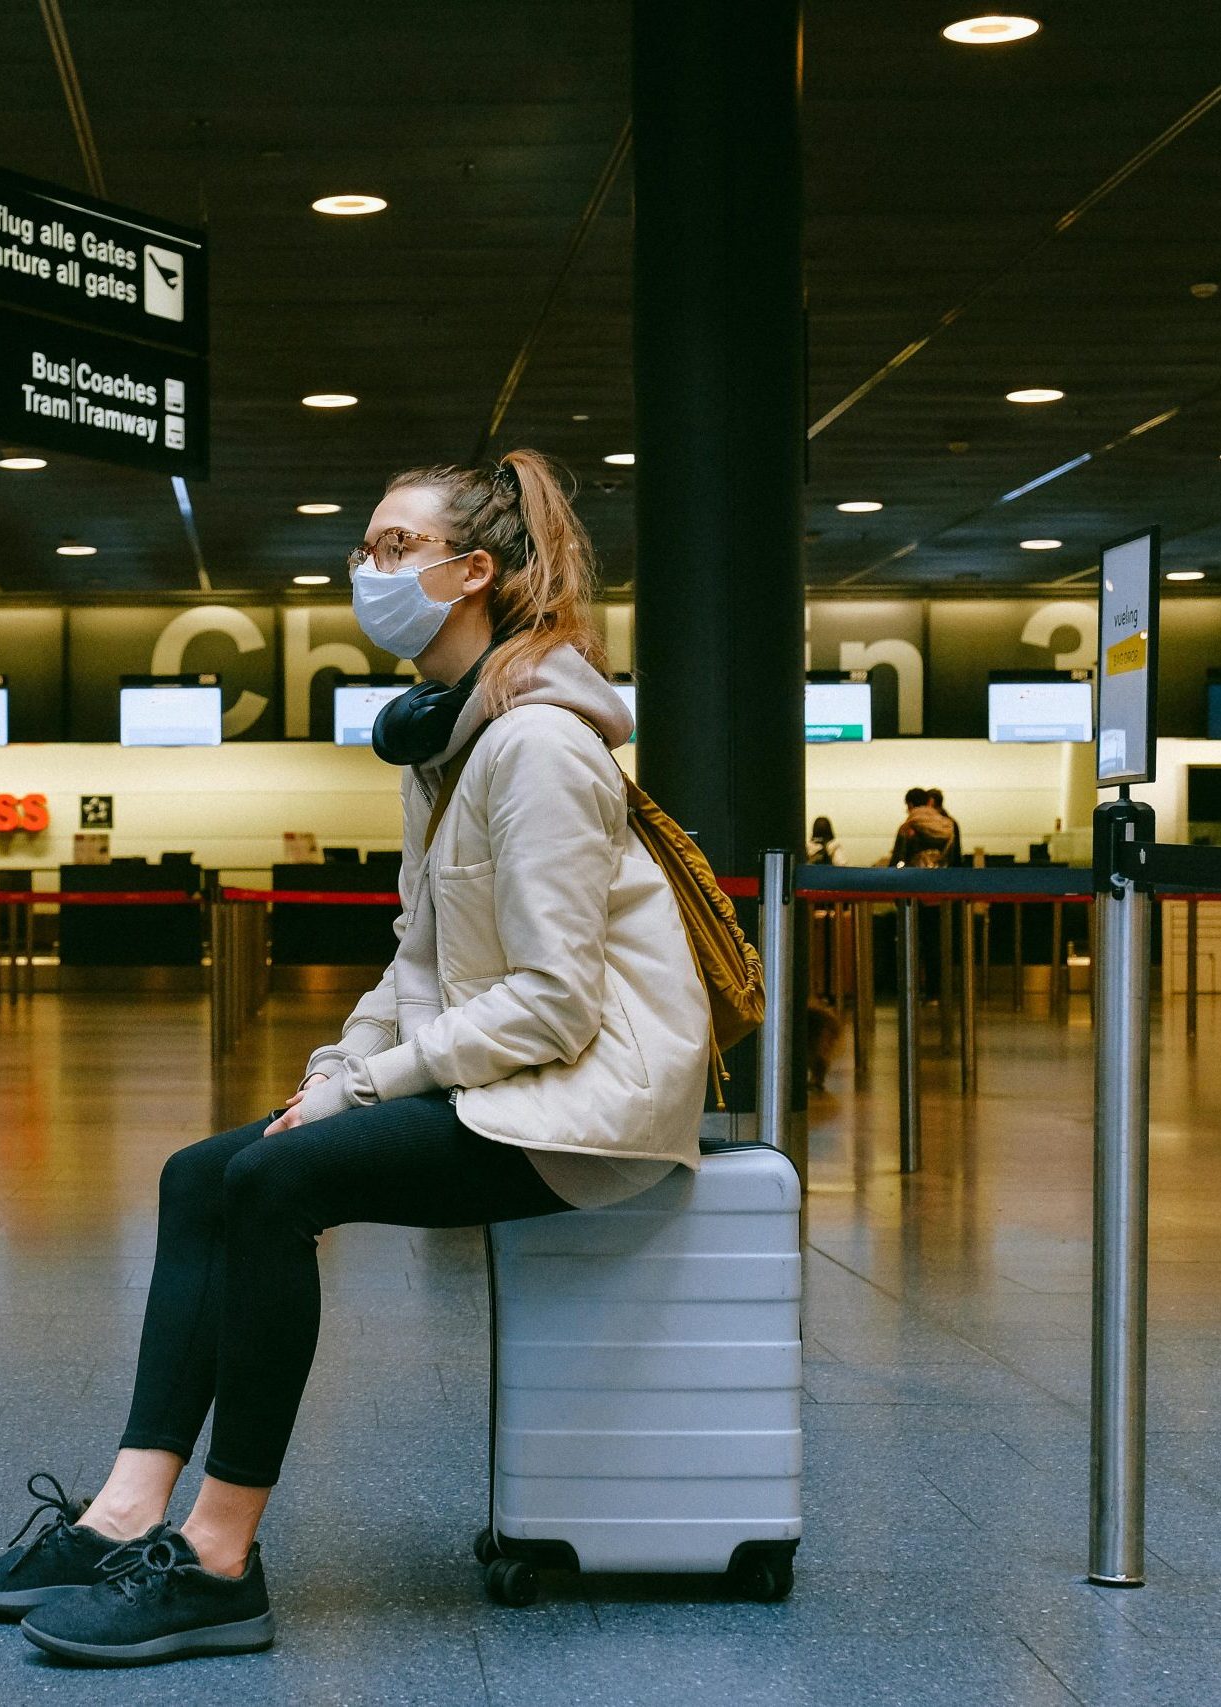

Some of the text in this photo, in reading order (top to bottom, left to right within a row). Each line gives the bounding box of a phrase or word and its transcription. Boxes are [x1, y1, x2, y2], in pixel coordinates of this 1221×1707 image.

[40, 222, 76, 252] alle
[82, 232, 137, 271] Gates
[56, 259, 80, 288] all
[85, 272, 137, 304] gates
